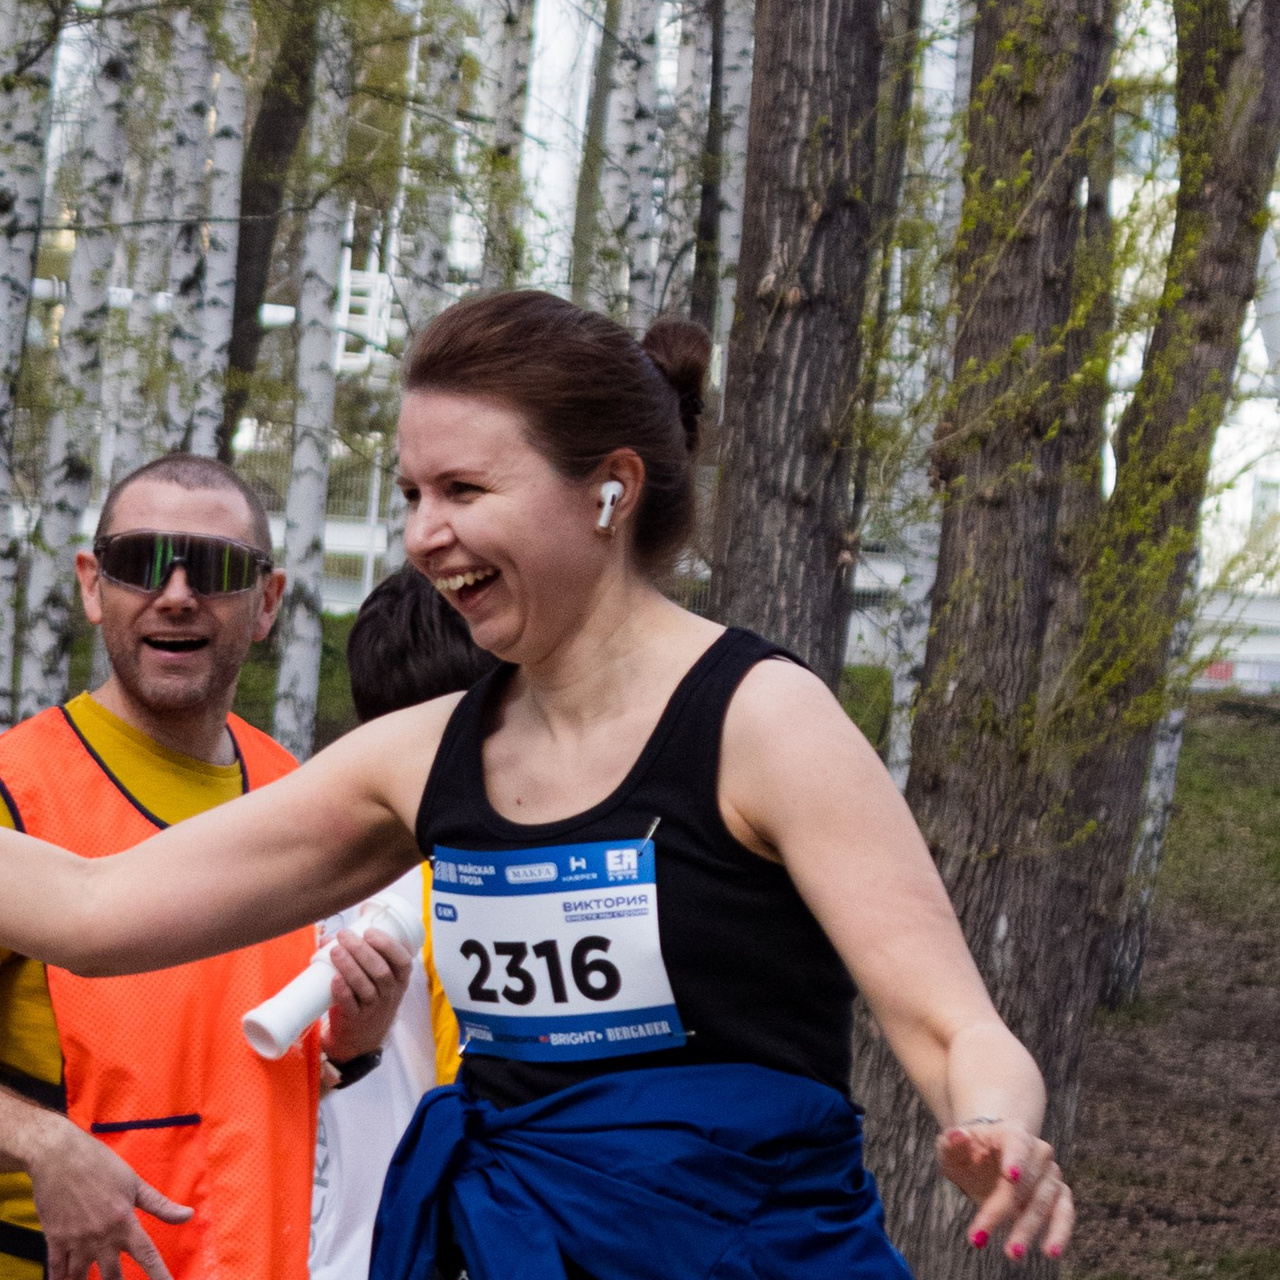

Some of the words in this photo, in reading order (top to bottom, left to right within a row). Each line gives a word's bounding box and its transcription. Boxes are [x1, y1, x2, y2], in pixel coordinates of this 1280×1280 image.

[458, 863, 496, 876] МАЙСКАЯ
[512, 867, 552, 879] MAKFA
[459, 875, 484, 886] ГРОЗА
[562, 872, 598, 882] HARPER
[563, 895, 648, 912] ВИКТОРИЯ
[460, 935, 621, 1006] 2316
[550, 1031, 596, 1046] BRIGHT
